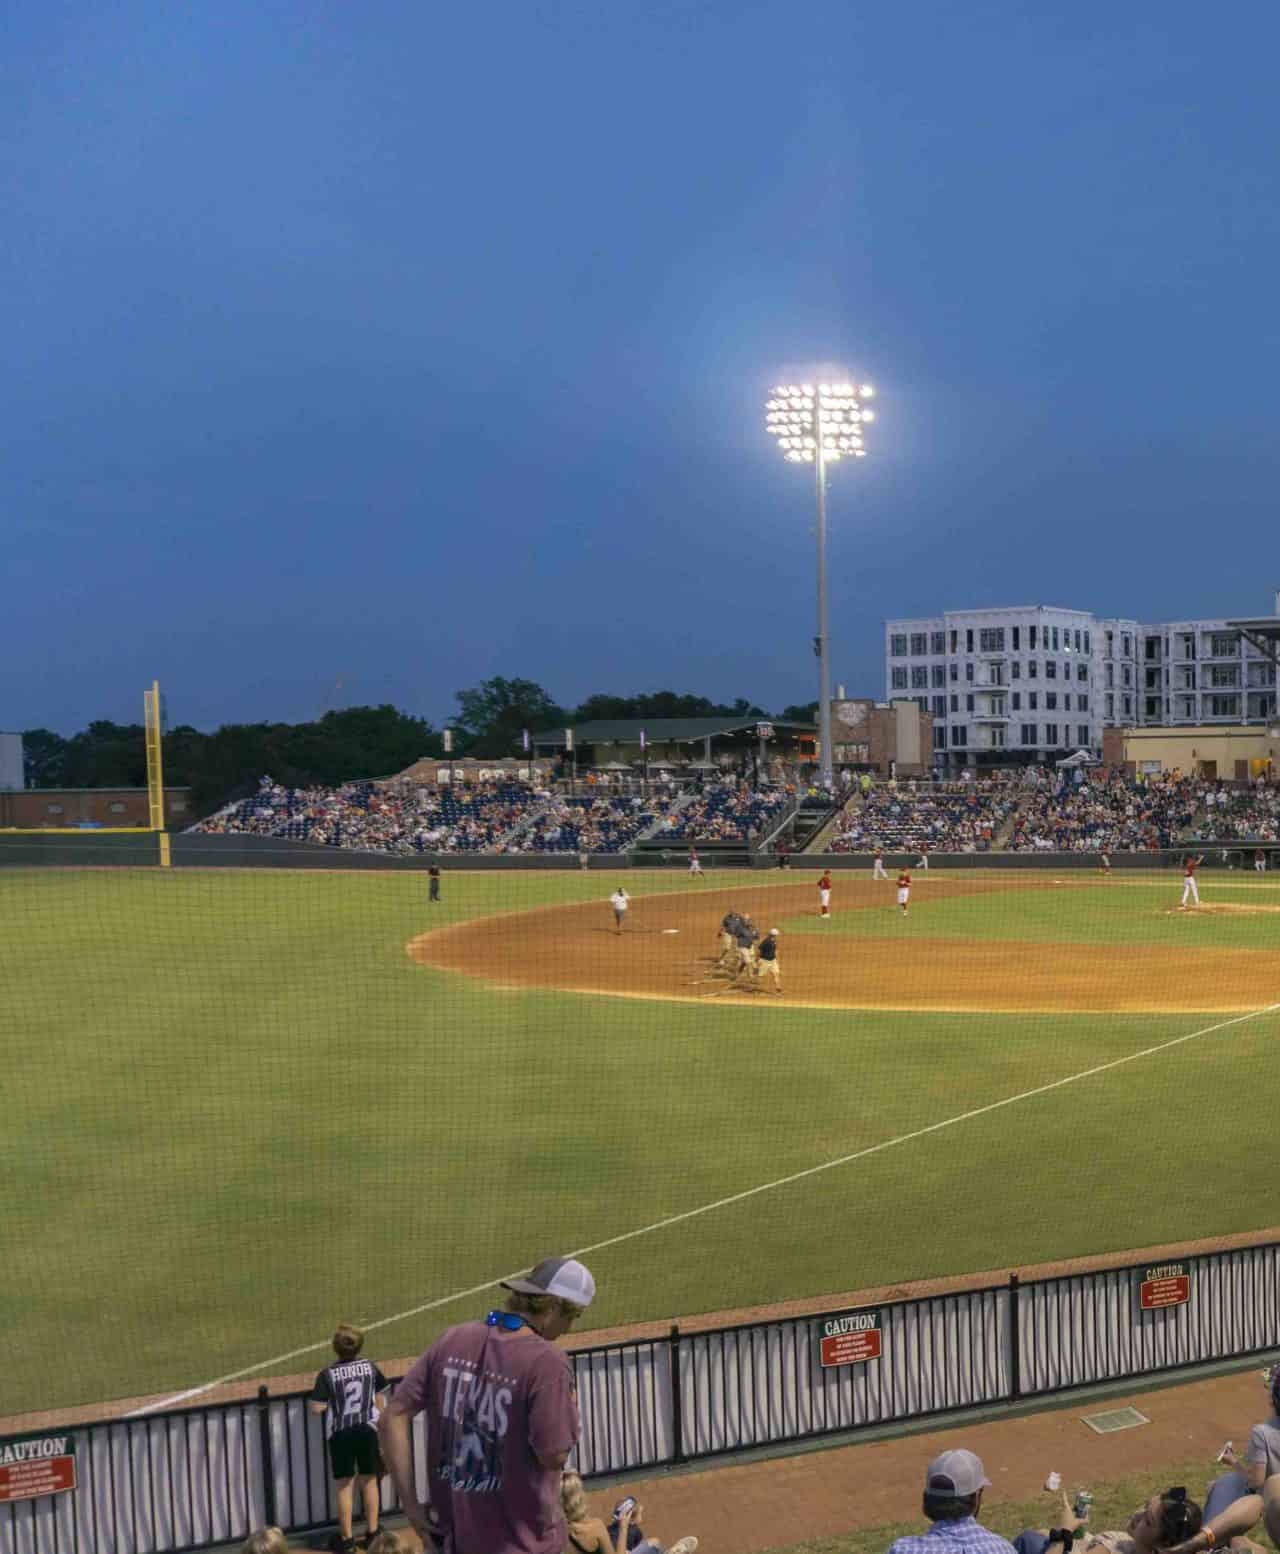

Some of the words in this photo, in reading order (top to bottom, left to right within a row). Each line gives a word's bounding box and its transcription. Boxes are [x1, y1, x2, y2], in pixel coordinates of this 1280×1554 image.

[1146, 1264, 1183, 1280] CAUTION
[825, 1314, 876, 1336] CAUTION
[344, 1381, 362, 1415] 2
[442, 1367, 513, 1437] TEXAS
